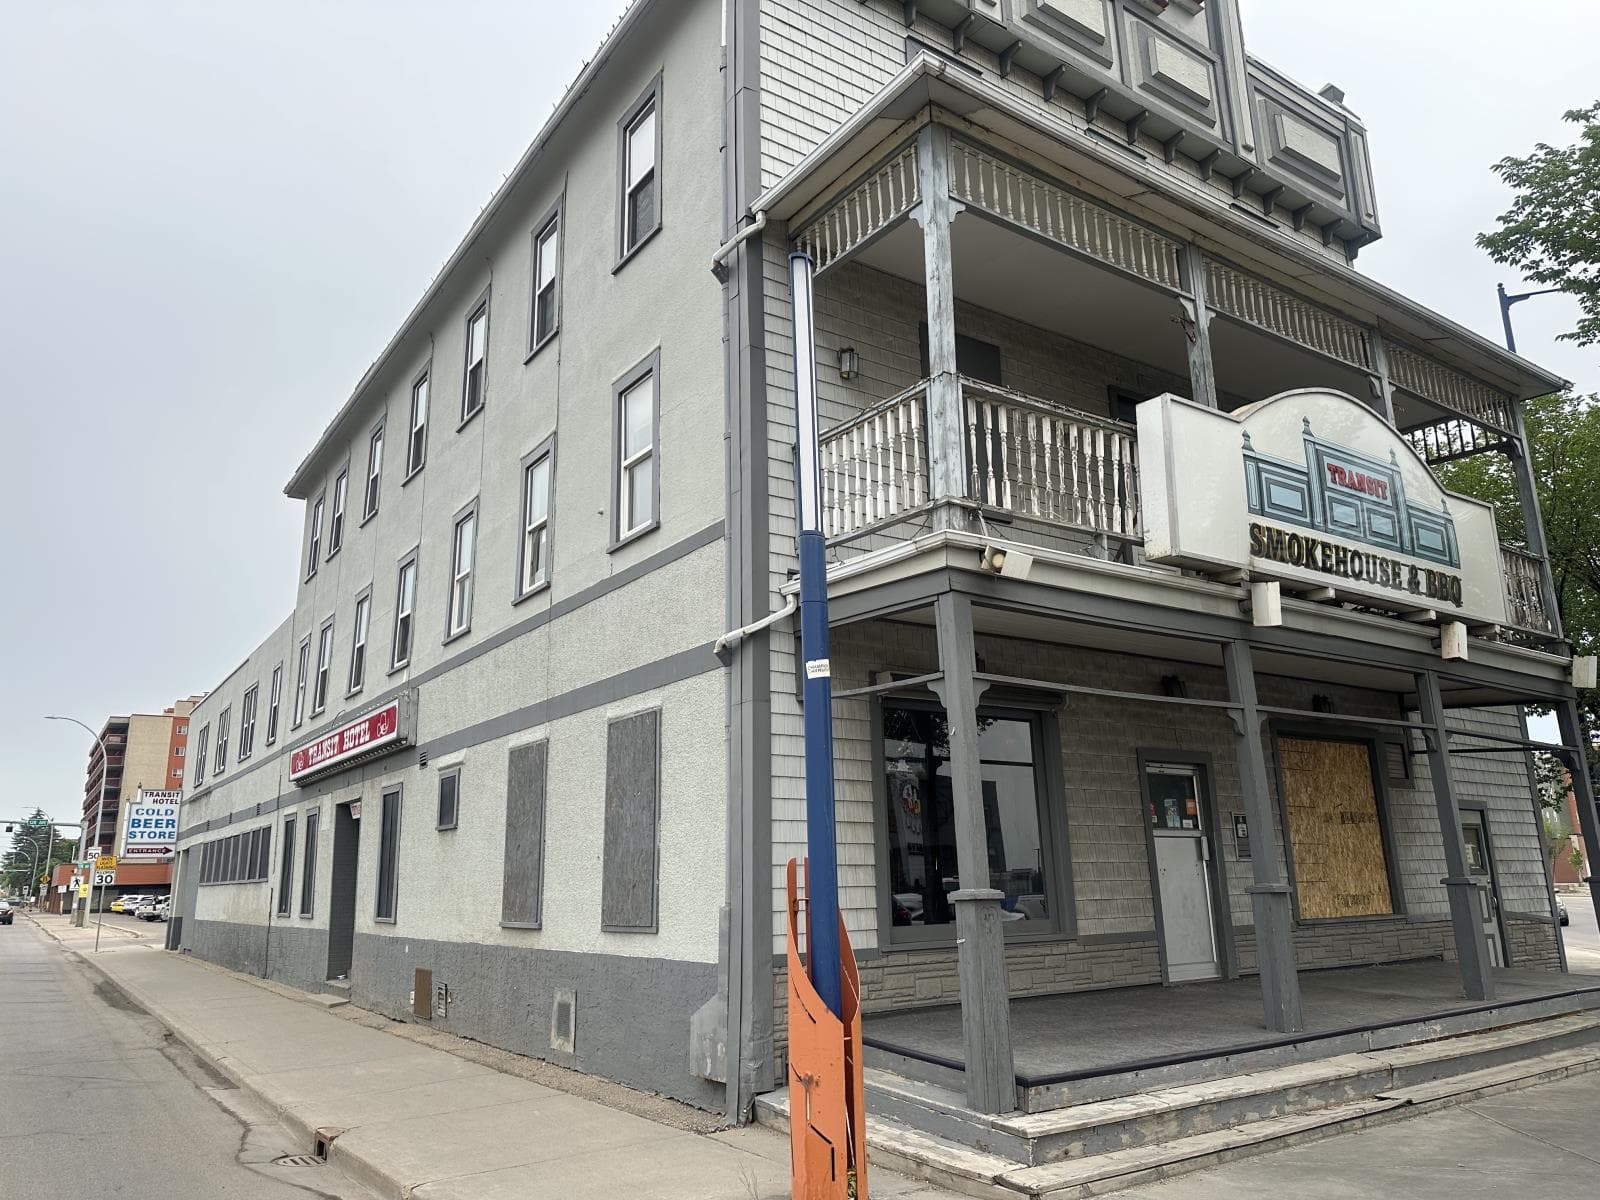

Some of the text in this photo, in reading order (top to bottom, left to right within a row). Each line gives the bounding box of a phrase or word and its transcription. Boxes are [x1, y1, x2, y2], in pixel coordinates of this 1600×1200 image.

[1327, 463, 1388, 500] TRANSIT
[1249, 522, 1464, 608] SMOKEHOUSE & BBQ
[308, 720, 371, 766] TRANSIT HOTEL
[135, 808, 174, 816] COLD
[130, 818, 176, 829] BEER
[128, 830, 176, 839] STORE
[96, 874, 113, 884] 30
